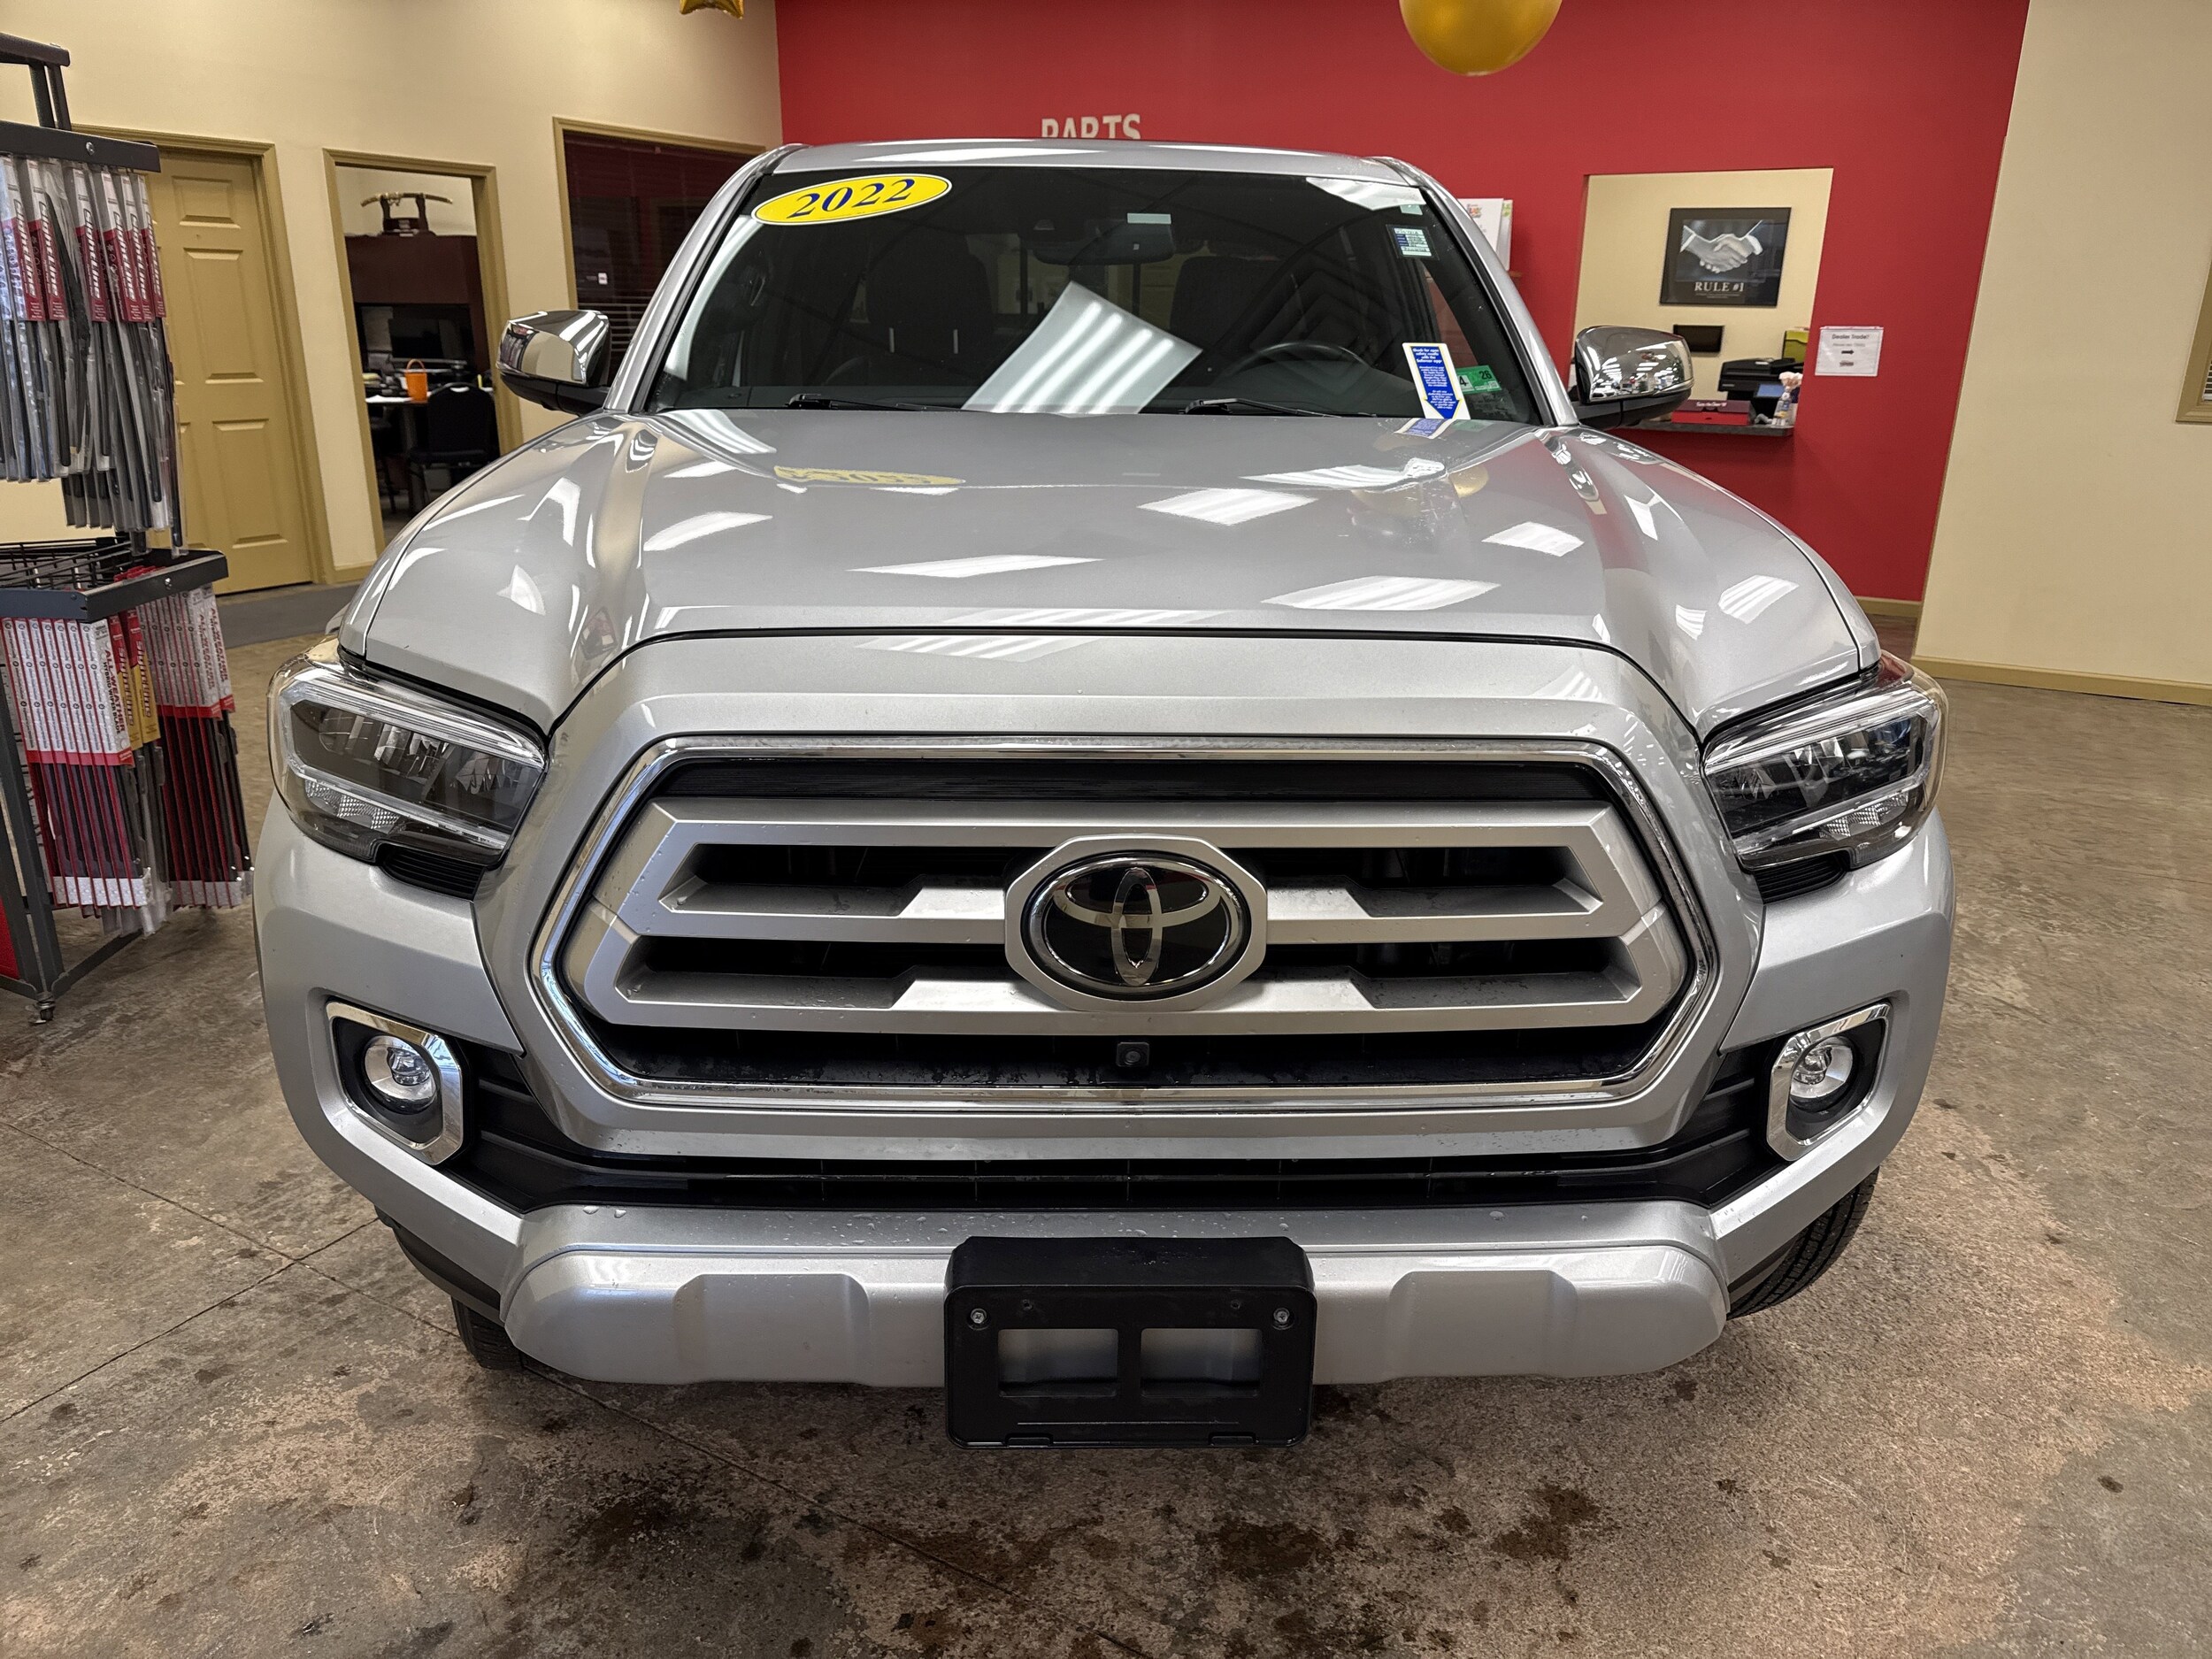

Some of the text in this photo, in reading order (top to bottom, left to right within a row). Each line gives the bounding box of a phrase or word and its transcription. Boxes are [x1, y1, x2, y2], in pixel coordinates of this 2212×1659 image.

[786, 178, 916, 219] 2022
[1694, 281, 1730, 292] RULE
[1479, 370, 1493, 380] 26
[103, 661, 111, 687] HYBRID
[107, 687, 116, 711] WIPER
